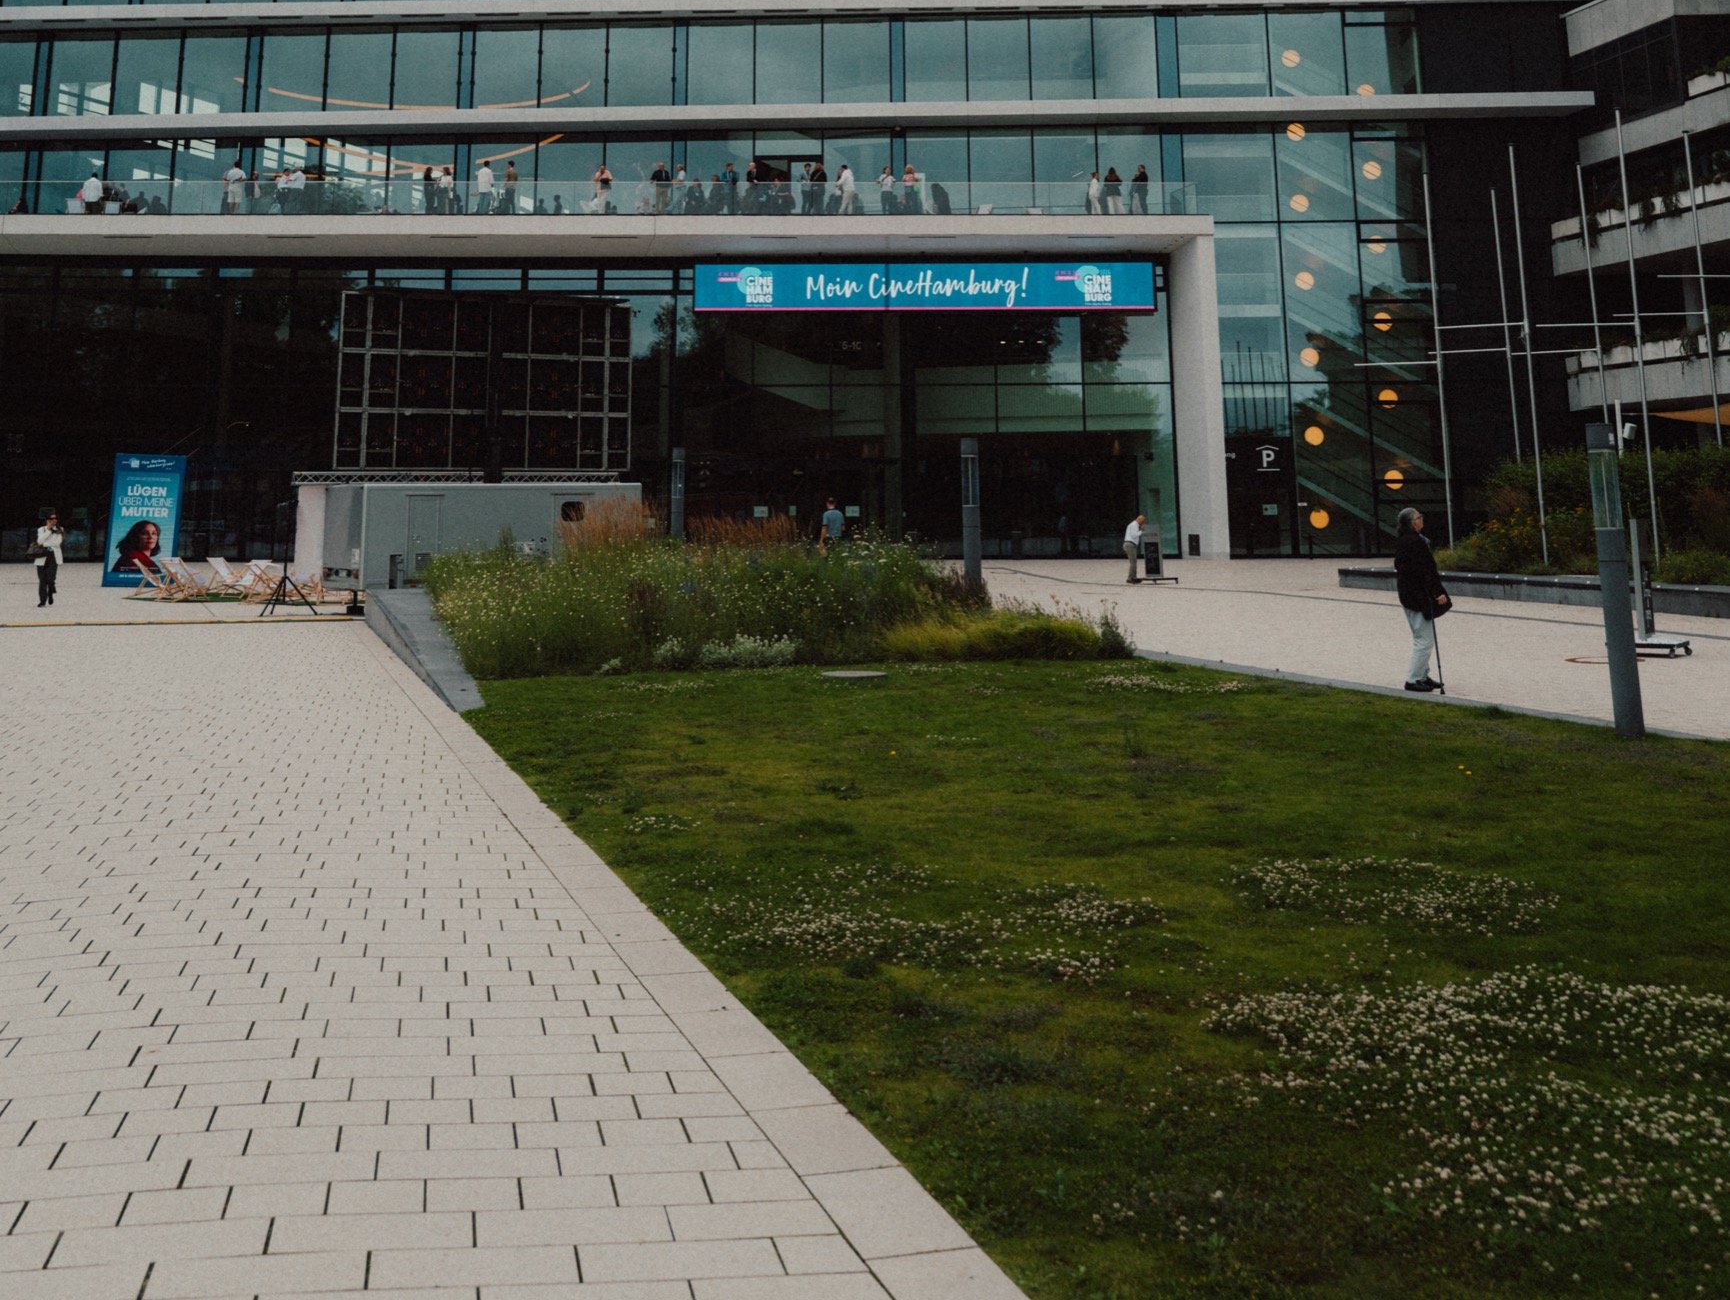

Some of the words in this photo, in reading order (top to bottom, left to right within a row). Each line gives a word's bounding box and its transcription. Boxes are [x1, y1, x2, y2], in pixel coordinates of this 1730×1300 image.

[746, 276, 773, 286] CINE
[1084, 275, 1111, 285] CINE
[746, 286, 773, 295] HAM
[806, 274, 863, 300] Moin
[868, 267, 1029, 307] CineHamburg!
[1084, 284, 1111, 293] HAM
[746, 294, 773, 304] BURG
[1084, 293, 1112, 302] BURG
[1262, 450, 1275, 468] P
[127, 484, 167, 497] LÜGEN
[118, 495, 142, 506] ÜBER
[144, 497, 173, 507] MEINE
[121, 507, 169, 517] MUTTER
